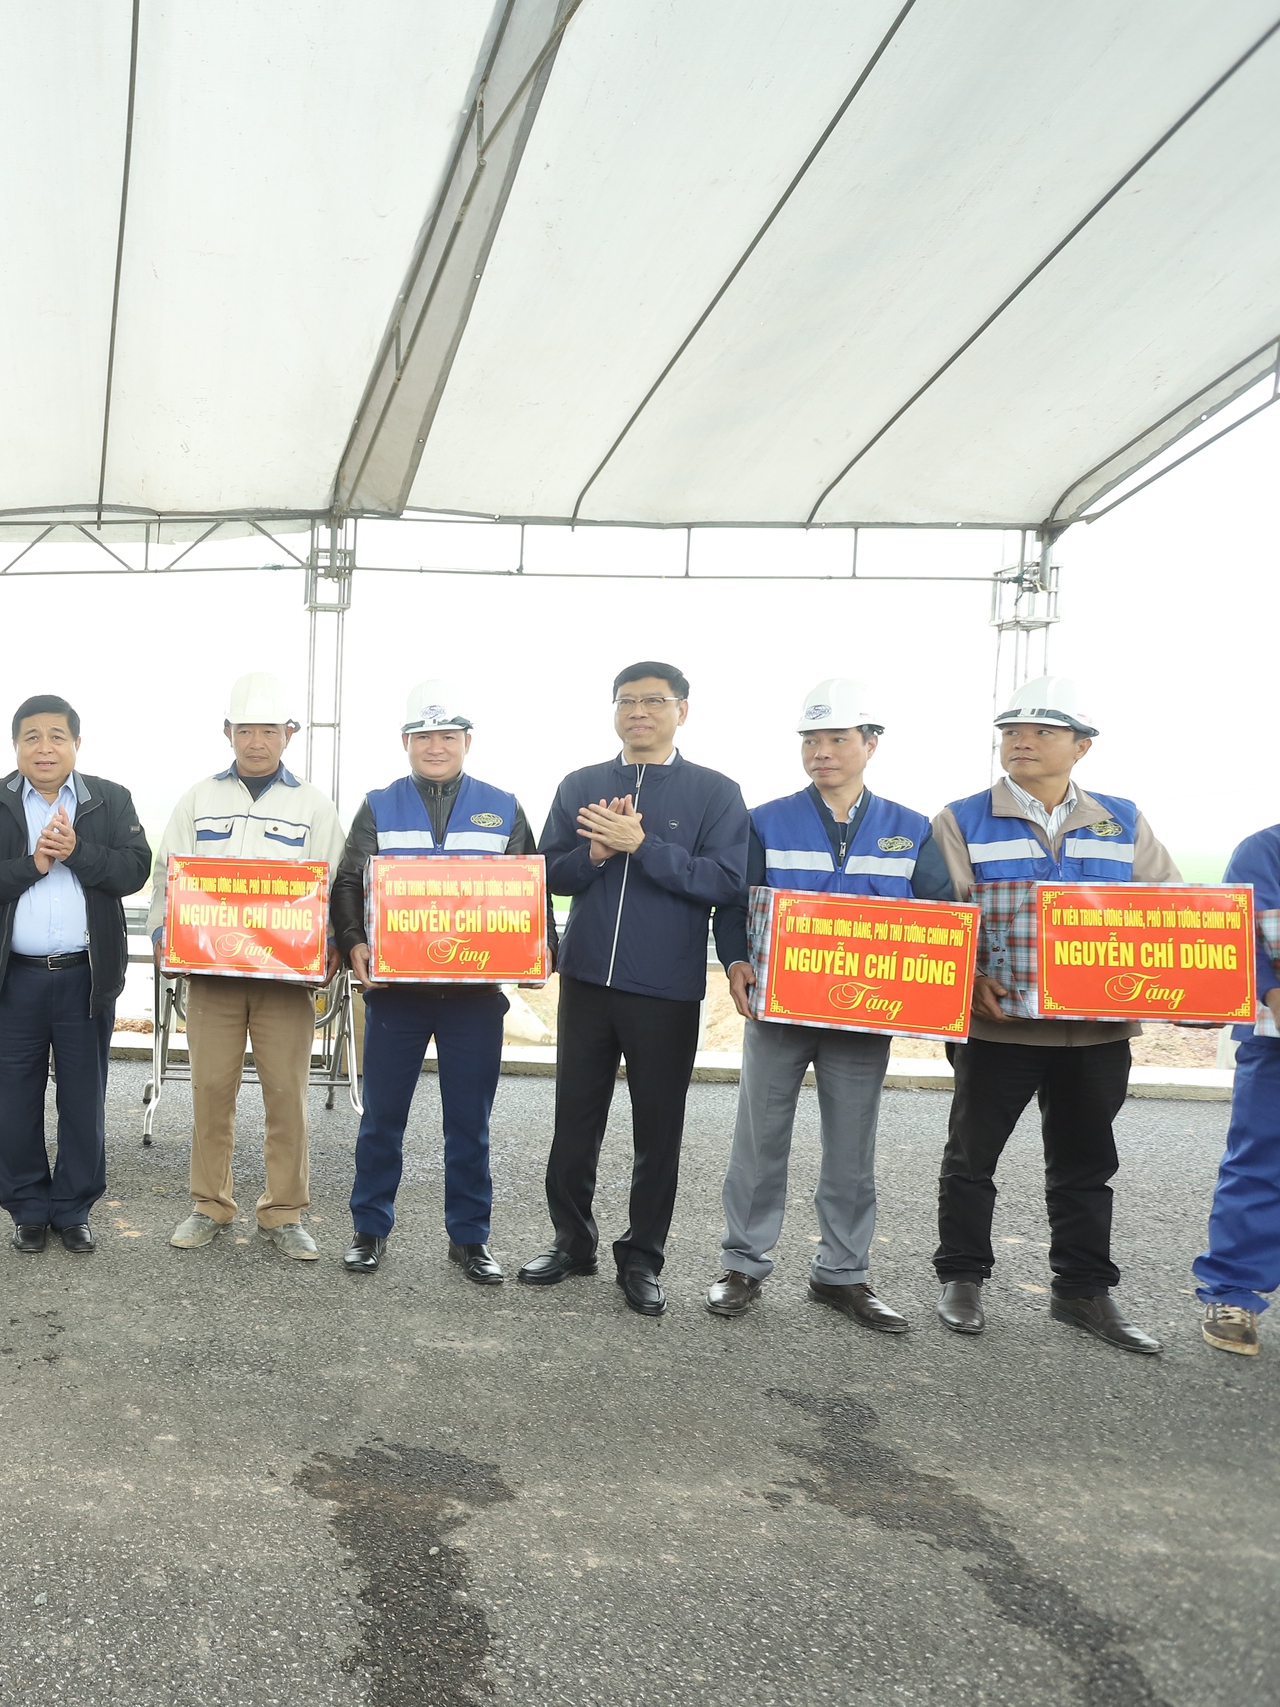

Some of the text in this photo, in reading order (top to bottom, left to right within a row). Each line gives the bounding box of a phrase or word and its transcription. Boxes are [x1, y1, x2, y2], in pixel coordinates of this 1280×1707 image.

[188, 874, 199, 892] VIÊN
[201, 877, 217, 892] TRUNG
[249, 877, 260, 894] PHÓ
[394, 877, 406, 895] VIÊN
[408, 880, 425, 896] TRUNG
[460, 878, 472, 896] PHÓ
[504, 878, 521, 896] CHÍNH
[180, 898, 313, 931] NGUYỄN CHÍ DŨNG
[387, 901, 531, 933] NGUYỄN CHÍ DŨNG
[785, 909, 964, 946] ỦY VIÊN TRUNG ƯƠNG ĐẢNG, PHÓ THỦ TƯỚNG CHÍNH PHỦ
[1052, 902, 1241, 929] ỦY VIÊN TRUNG ƯƠNG ĐẢNG, PHÓ THỦ TƯỚNG CHÍNH PHỦ
[215, 932, 274, 964] Tặng
[427, 937, 490, 970] Tặng
[784, 942, 957, 986] NGUYỄN CHÍ DŨNG
[1054, 932, 1237, 970] NGUYỄN CHÍ DŨNG
[829, 982, 904, 1021] Tặng
[1105, 972, 1185, 1010] Tặng
